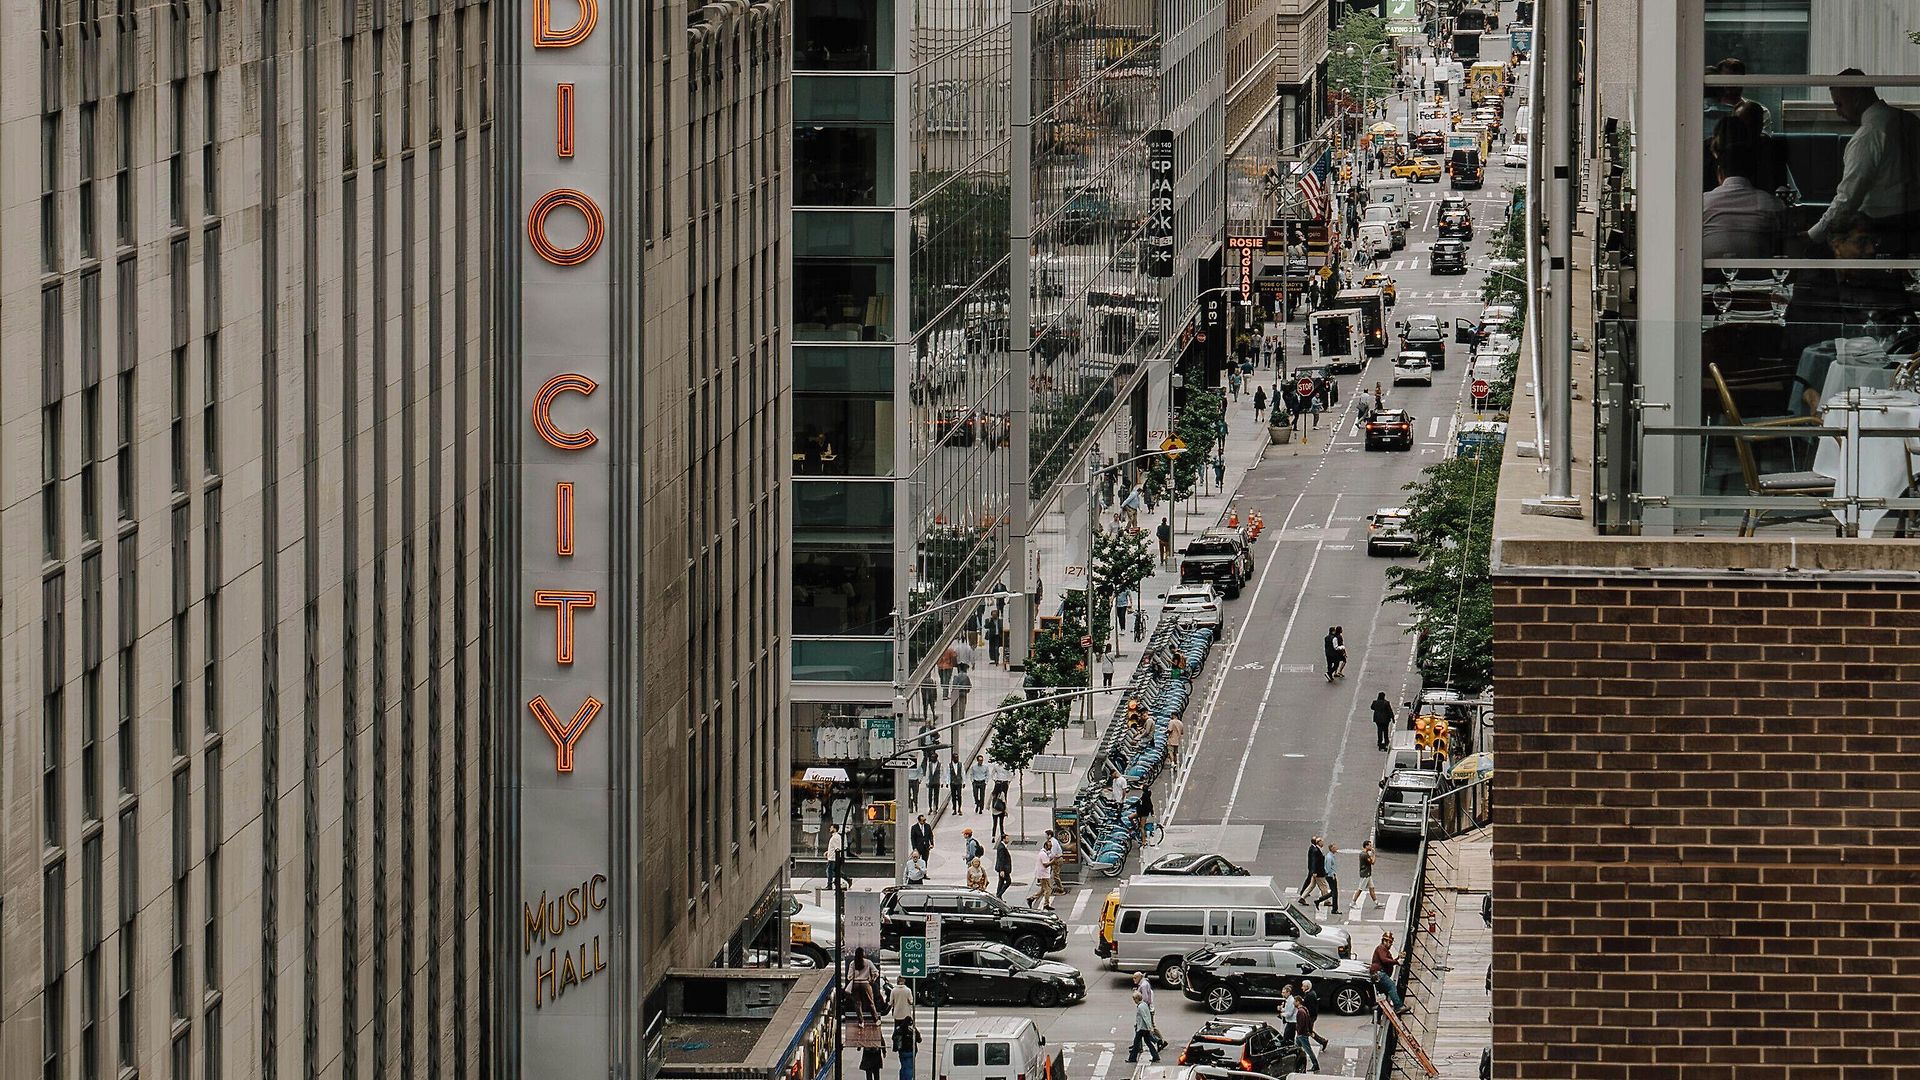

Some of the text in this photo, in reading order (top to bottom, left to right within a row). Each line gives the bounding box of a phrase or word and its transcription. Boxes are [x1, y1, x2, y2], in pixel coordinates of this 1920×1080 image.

[1420, 111, 1447, 119] FedEx
[1229, 238, 1264, 247] ROSIE
[1208, 301, 1218, 326] 135
[1298, 383, 1313, 391] STOP
[1471, 385, 1488, 393] STOP
[1148, 430, 1168, 439] 1271
[527, 372, 604, 772] CITY
[1064, 566, 1086, 576] 1271
[524, 873, 607, 955] MUSIC
[536, 934, 607, 1010] HALL
